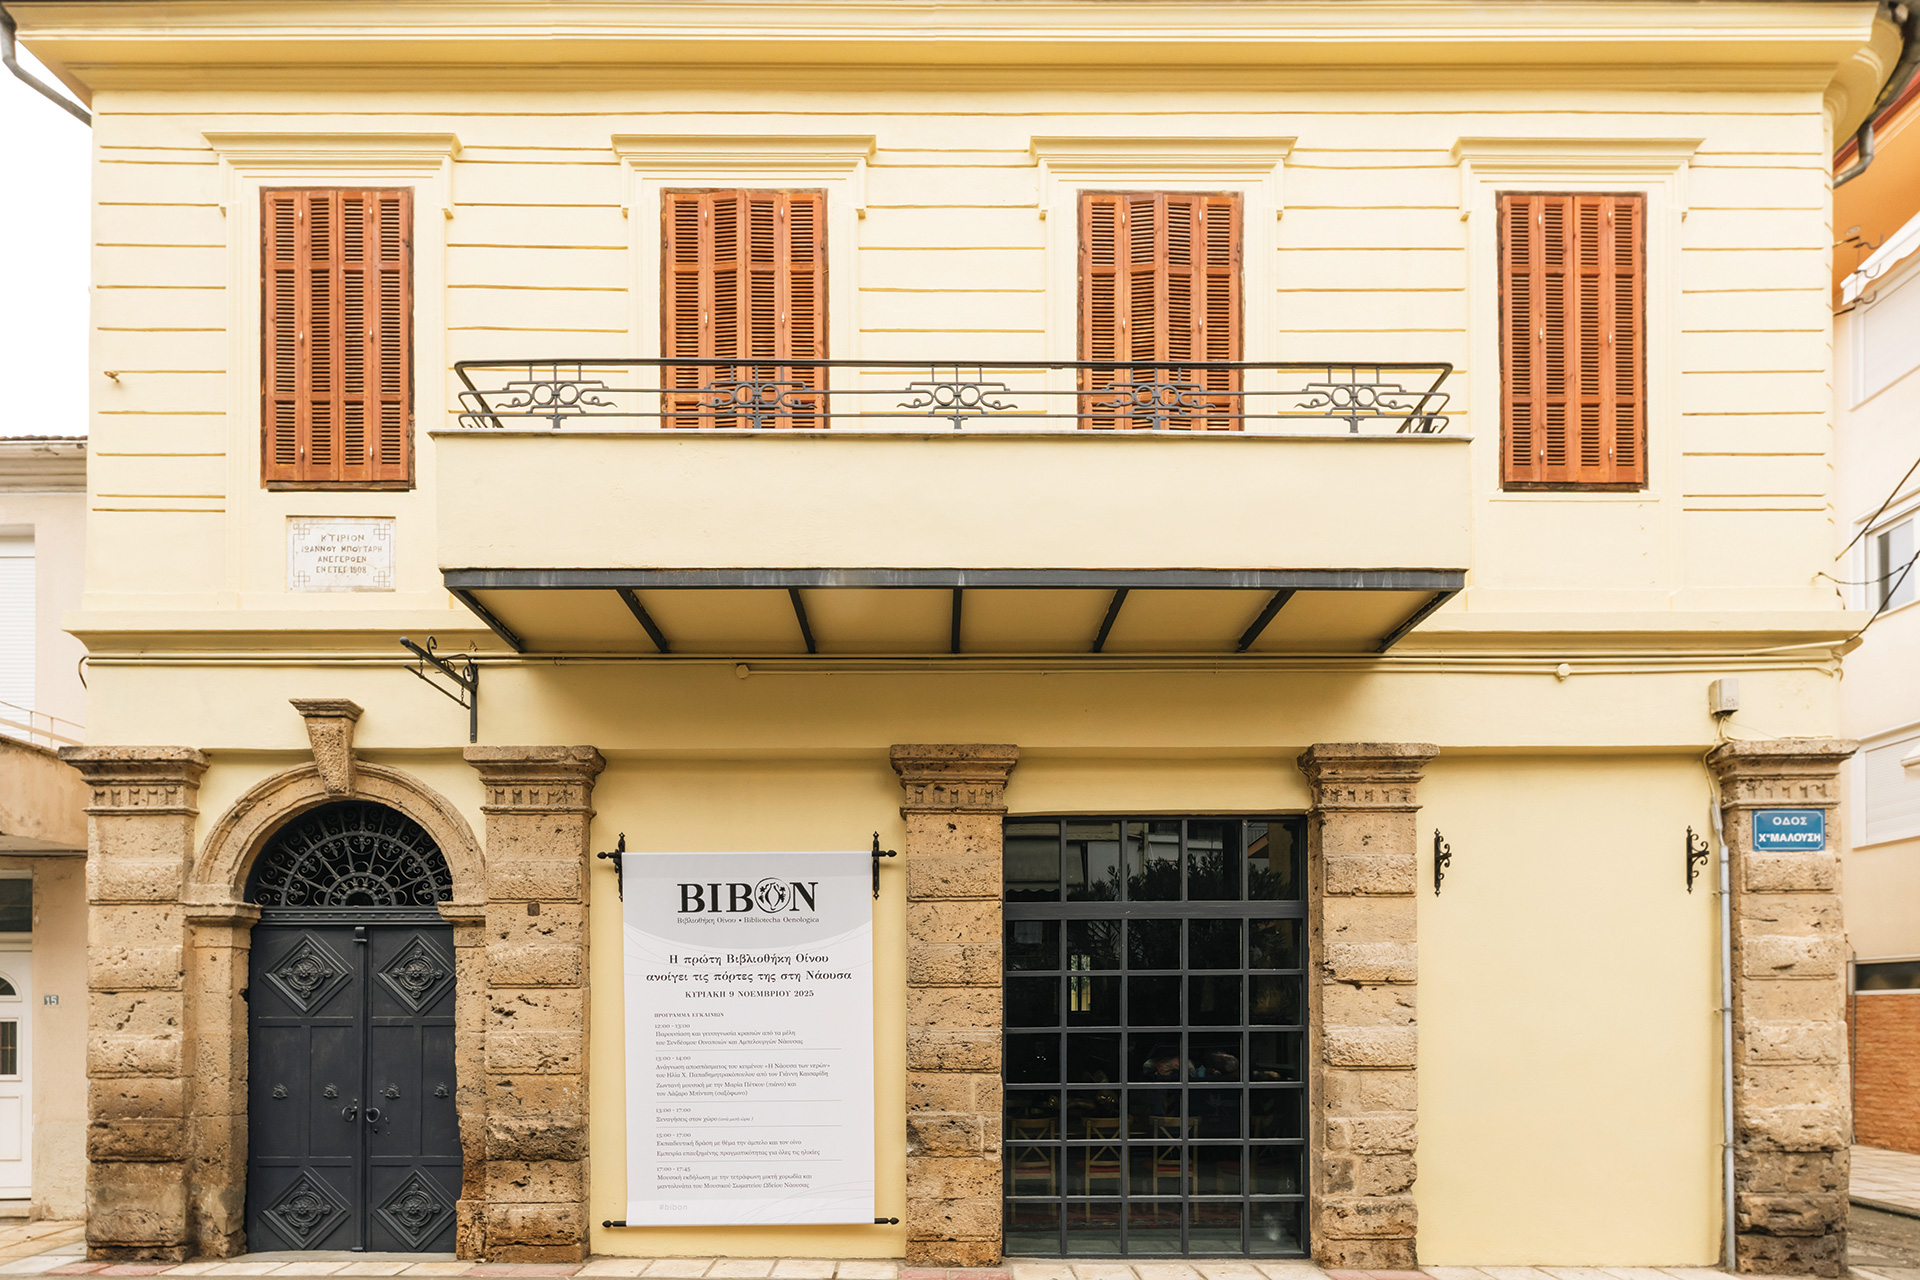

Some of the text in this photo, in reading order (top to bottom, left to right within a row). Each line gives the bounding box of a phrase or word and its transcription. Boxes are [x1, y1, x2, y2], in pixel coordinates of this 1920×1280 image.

[321, 534, 364, 542] ΚΤΙΡΙΟΝ
[1772, 817, 1807, 825] ΟΔΟΣ
[782, 916, 820, 924] Oenologica
[669, 953, 829, 966] Η πρώτη Βιβλιοθήκη Οίνου
[646, 970, 852, 984] ανοίγει τις πόρτες της στη Νάουσα
[45, 995, 57, 1005] 15
[782, 1029, 795, 1037] μέλη
[658, 1203, 688, 1211] #bibon
